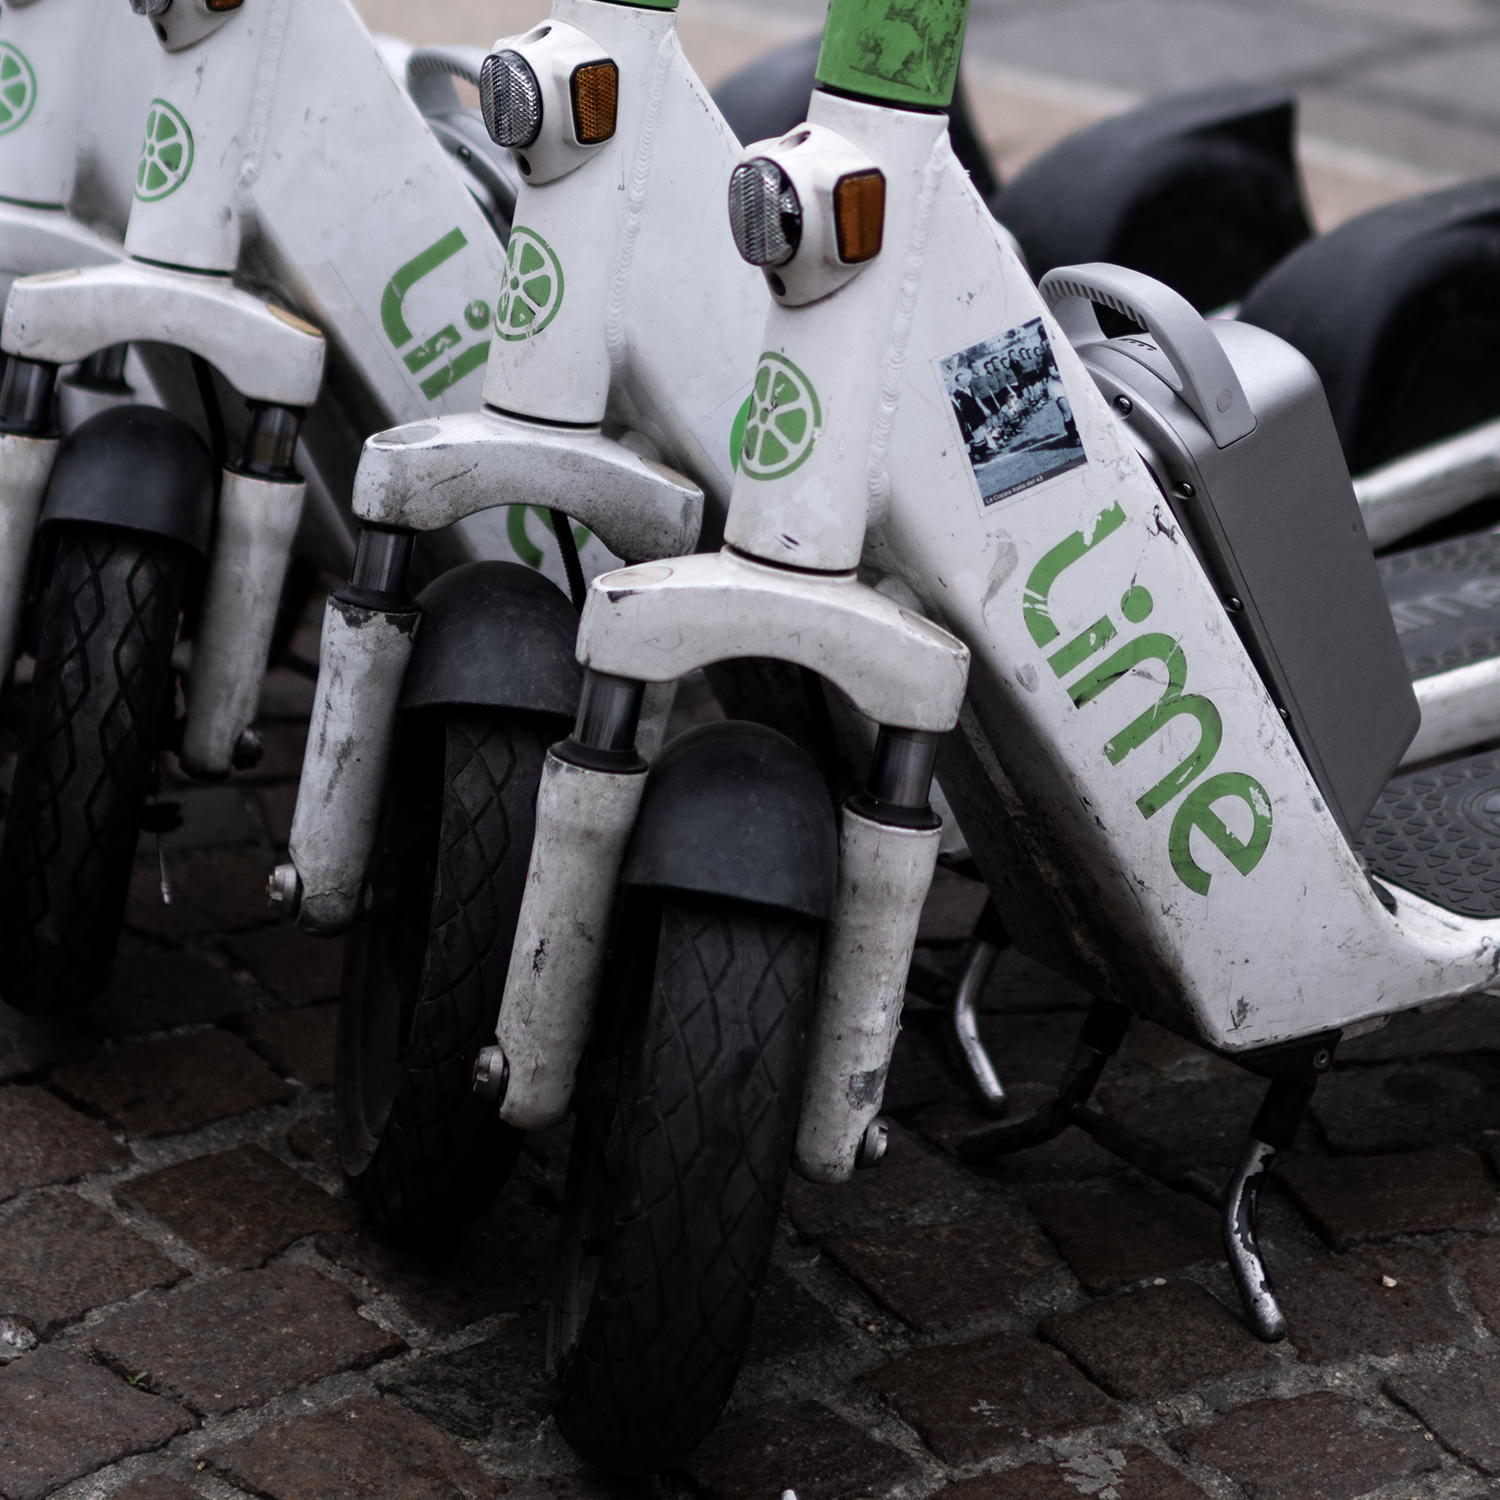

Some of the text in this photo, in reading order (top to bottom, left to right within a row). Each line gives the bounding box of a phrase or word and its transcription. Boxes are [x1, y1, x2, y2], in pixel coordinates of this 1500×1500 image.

[993, 490, 1012, 500] Coppa
[1026, 479, 1035, 487] del
[1023, 500, 1274, 897] Lime
